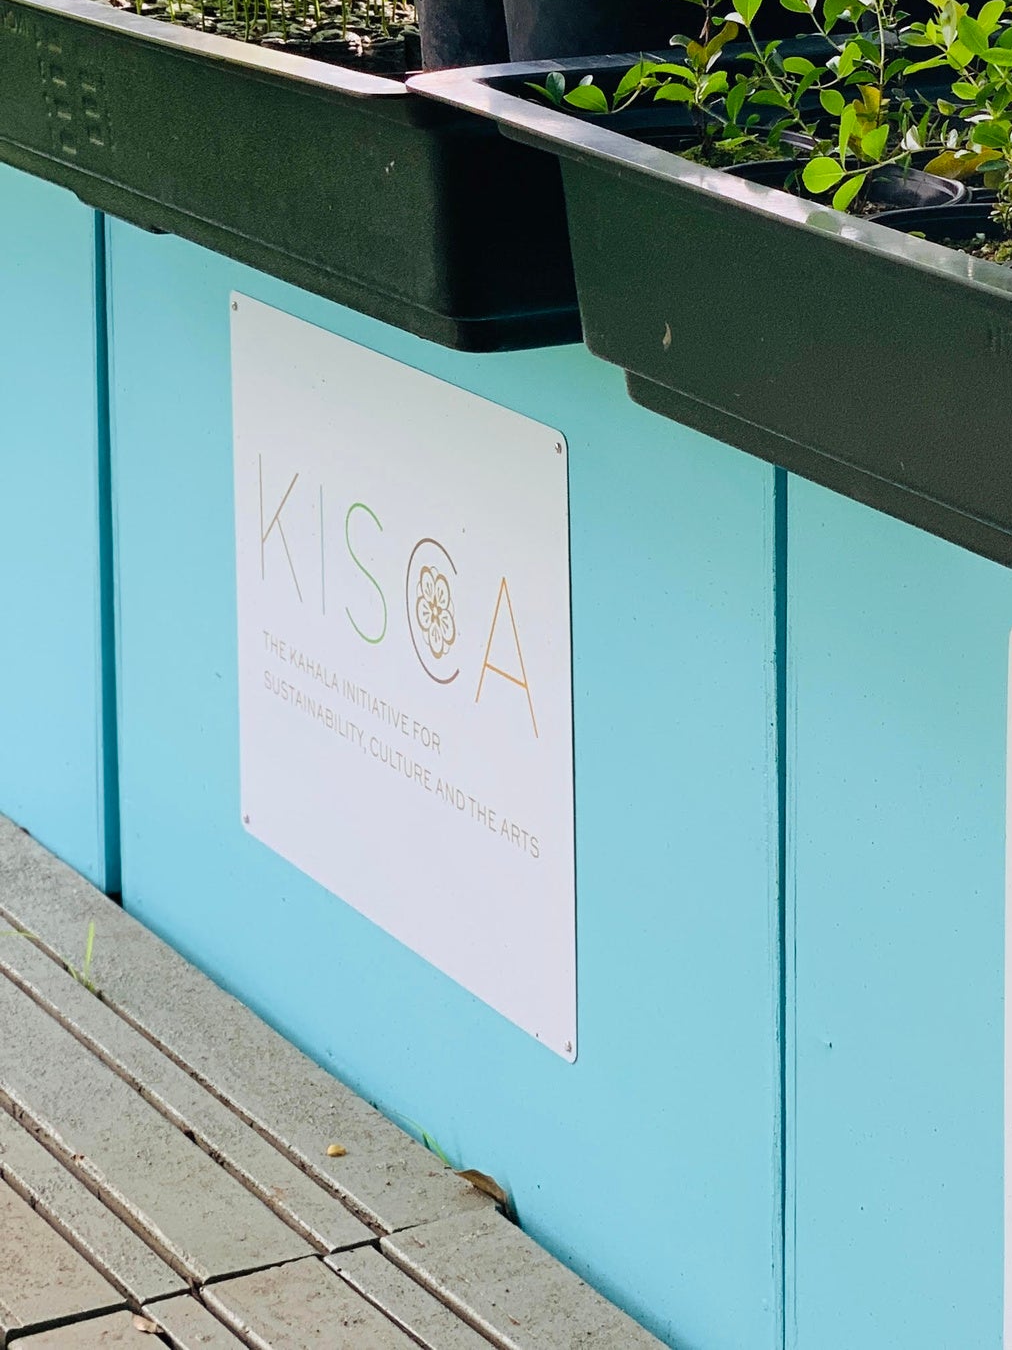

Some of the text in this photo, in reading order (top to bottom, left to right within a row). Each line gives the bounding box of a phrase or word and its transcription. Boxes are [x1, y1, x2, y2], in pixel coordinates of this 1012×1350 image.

[258, 452, 540, 740] KISCA
[262, 629, 441, 755] THE KAHALA INITIATIVE FOR
[263, 669, 540, 859] SUSTAINABILITY, CULTURE AND THE ARTS
